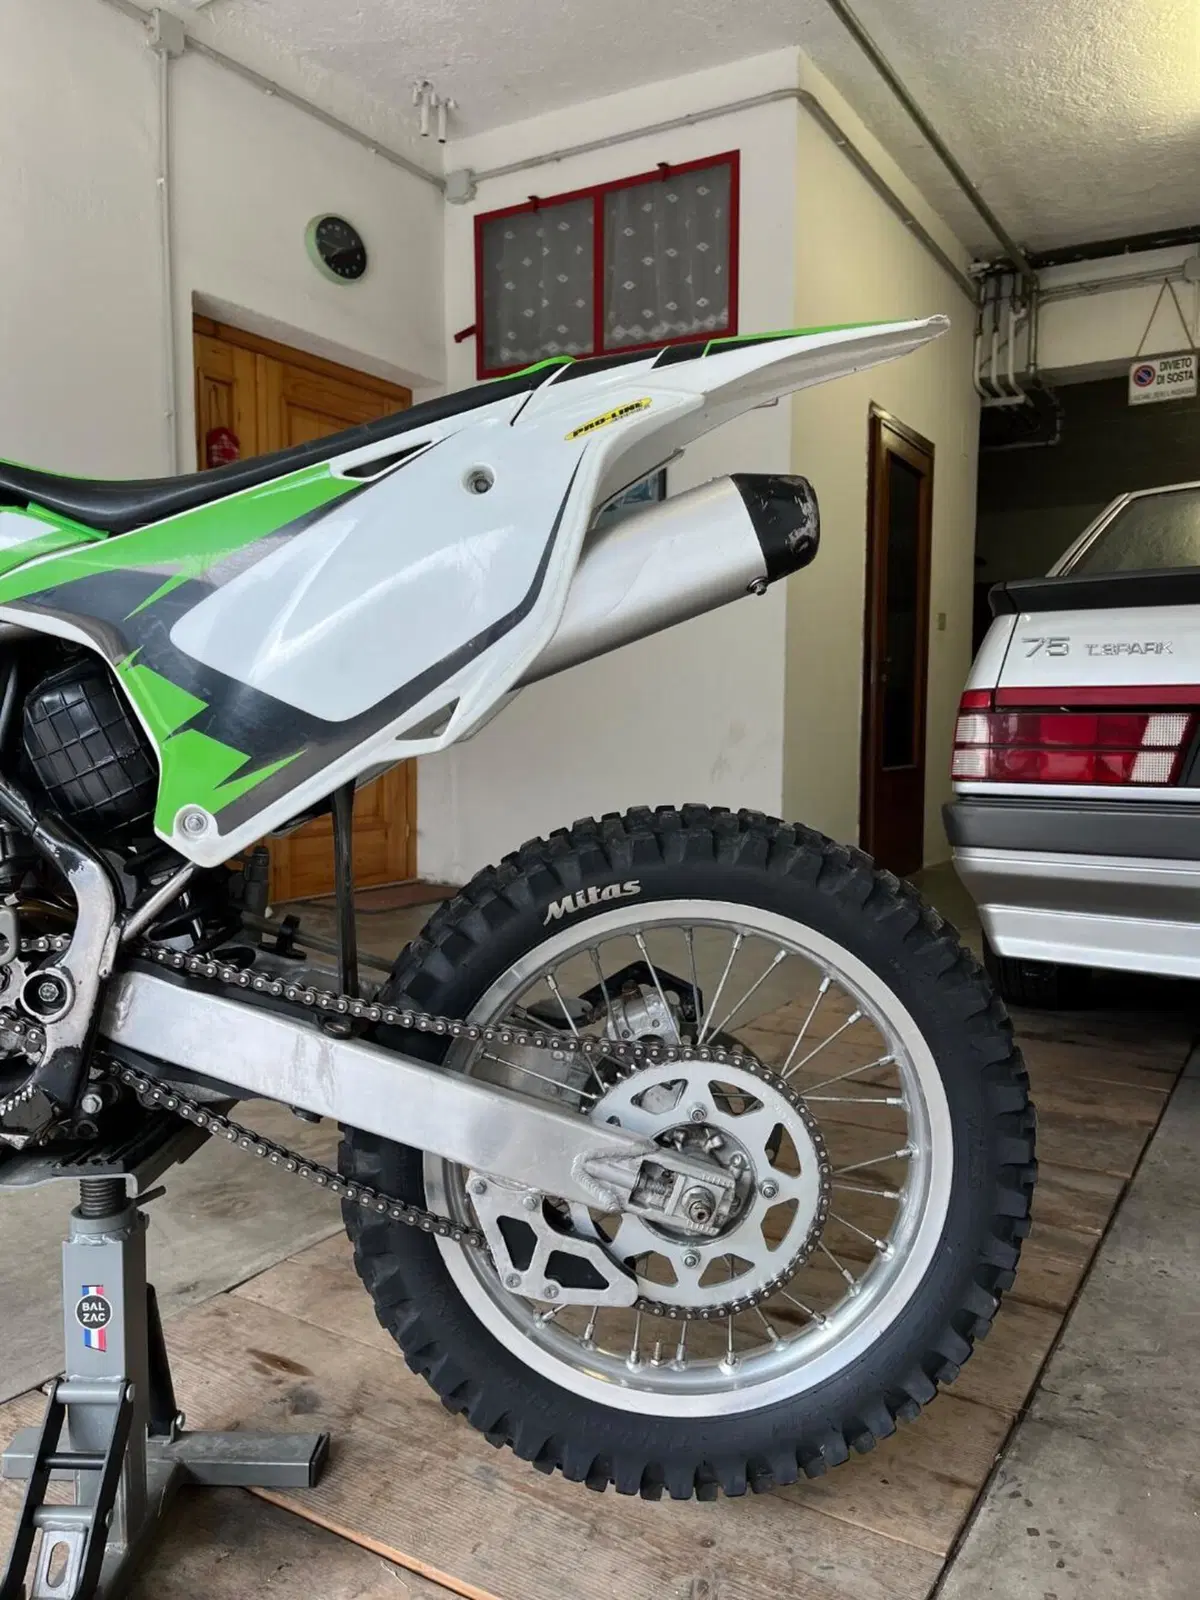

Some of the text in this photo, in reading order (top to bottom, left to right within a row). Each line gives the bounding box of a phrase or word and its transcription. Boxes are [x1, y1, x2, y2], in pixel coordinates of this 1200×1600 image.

[1159, 357, 1192, 372] DIVIETO
[1156, 370, 1194, 385] DI SOSTA
[1021, 636, 1071, 659] 75
[542, 879, 642, 927] Mitas
[82, 1302, 105, 1312] BAL
[82, 1312, 106, 1323] ZAC
